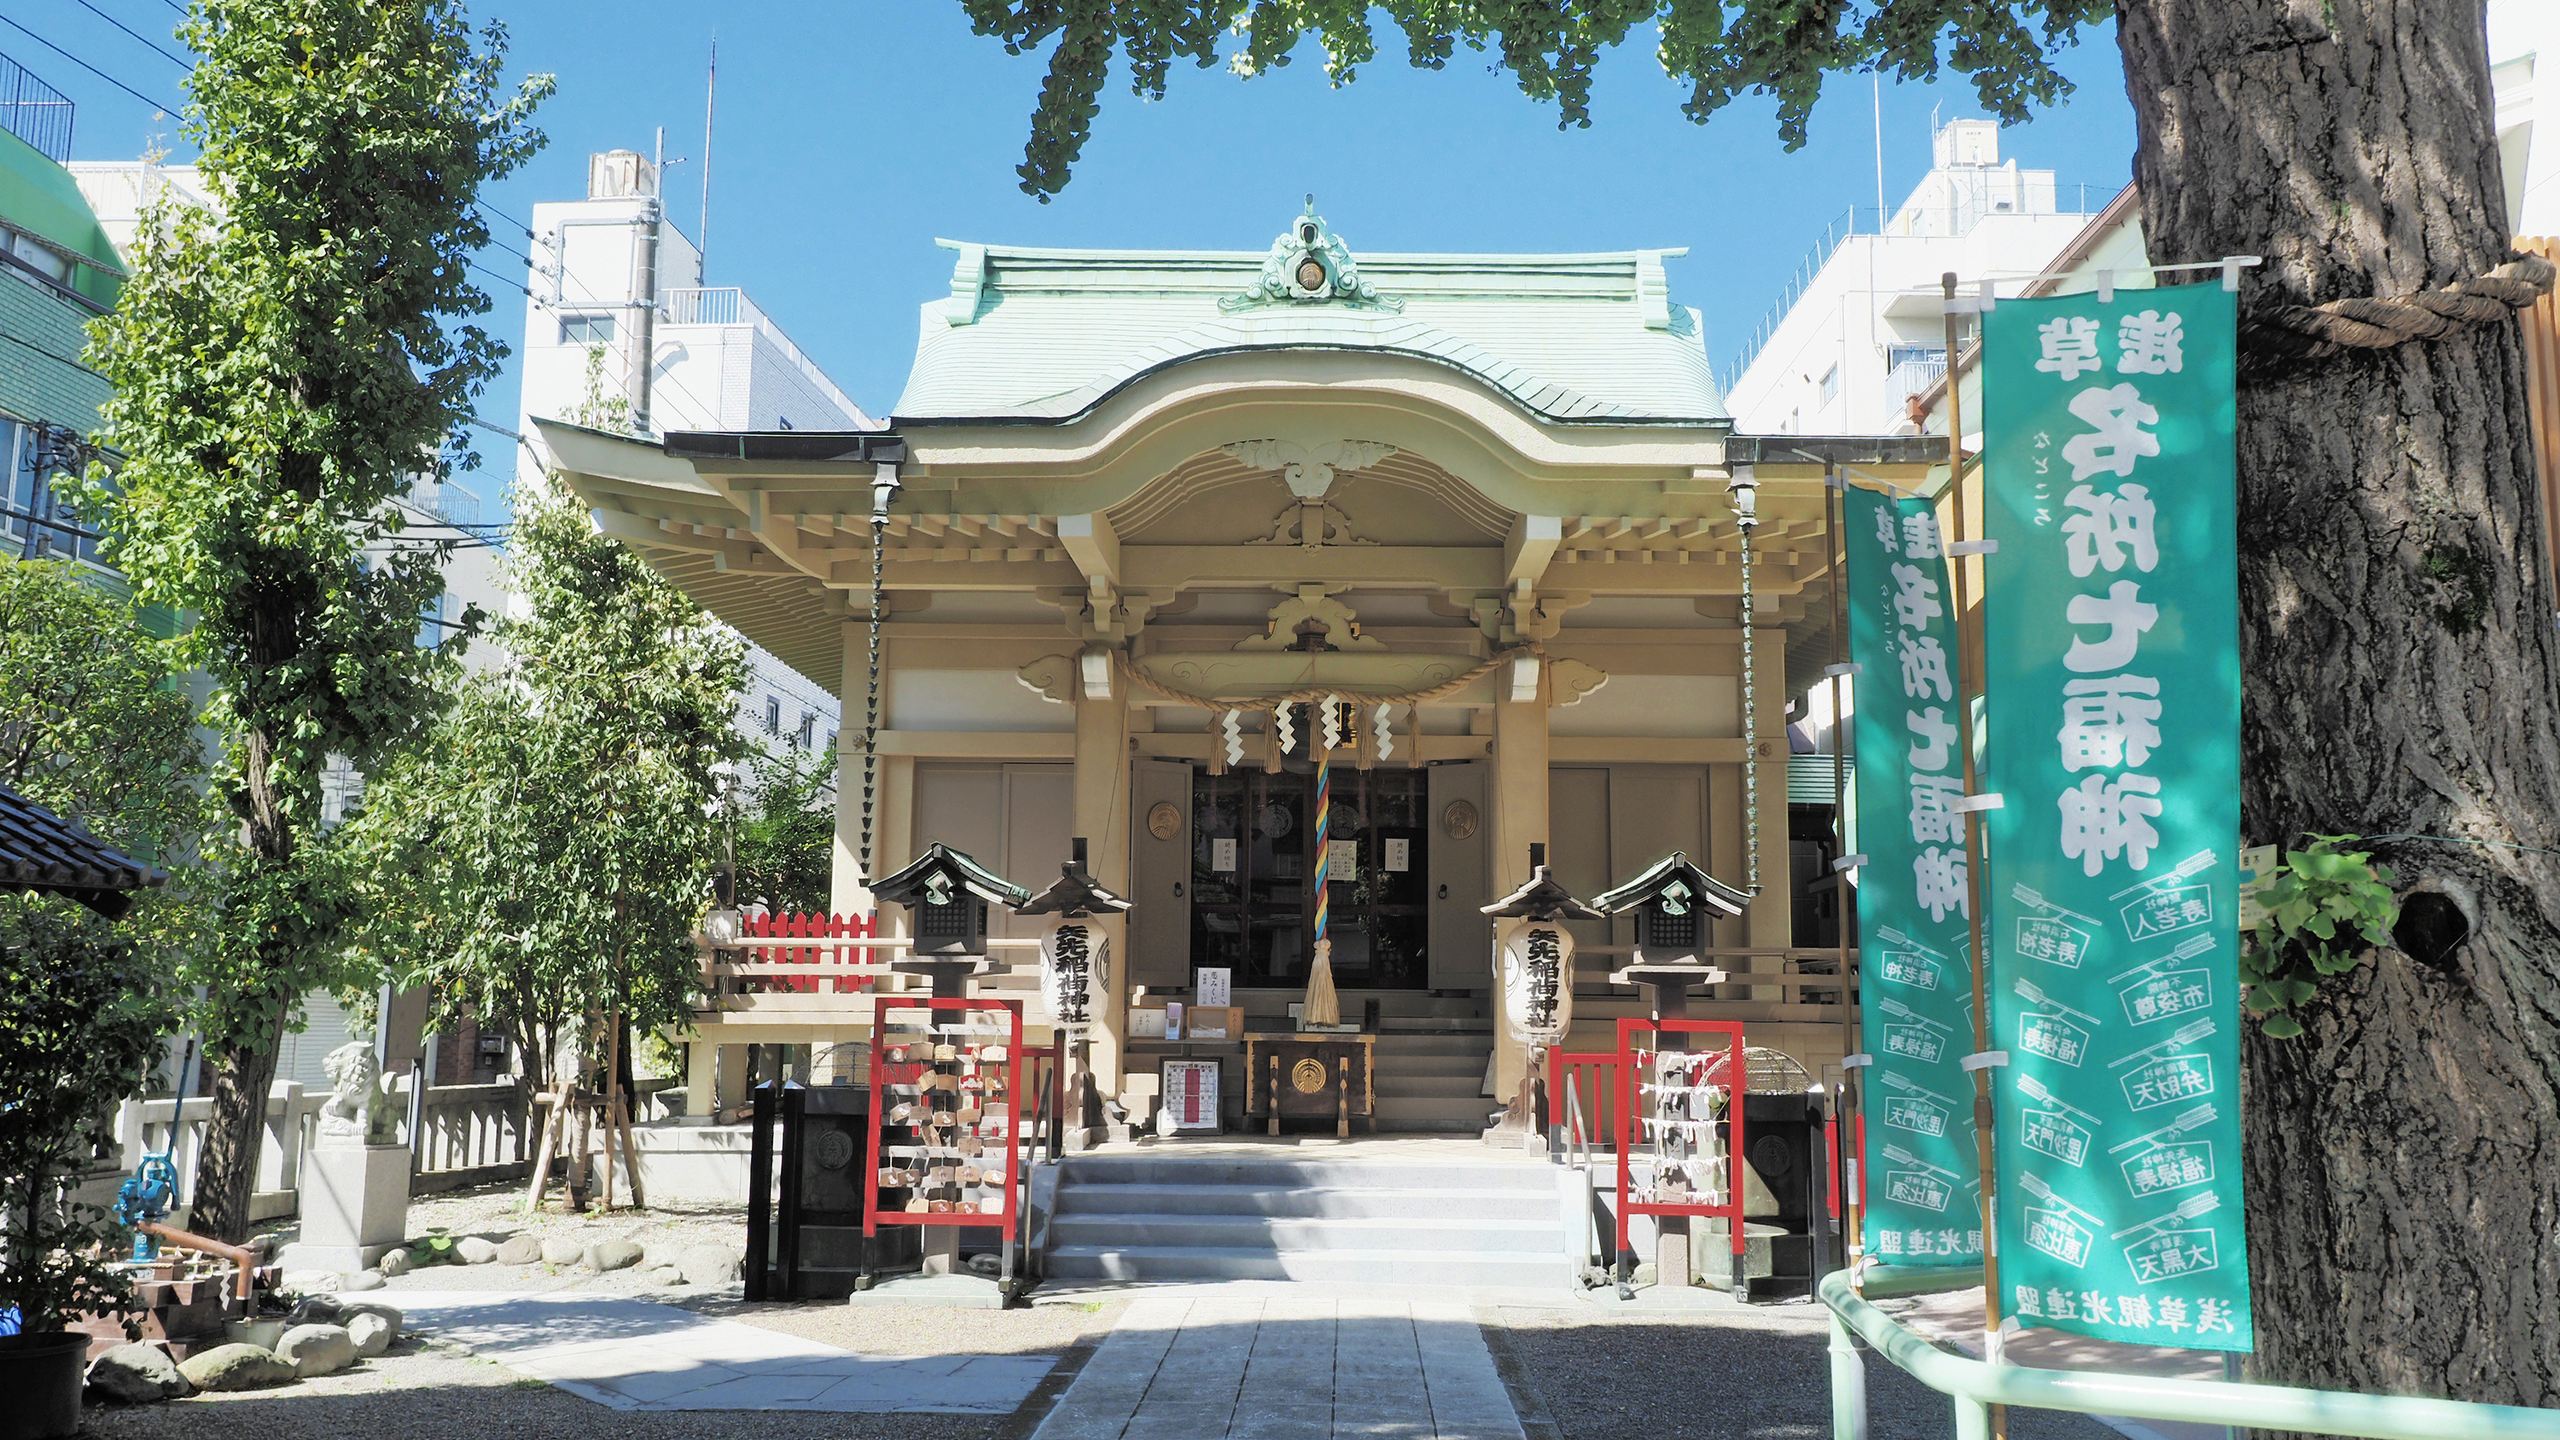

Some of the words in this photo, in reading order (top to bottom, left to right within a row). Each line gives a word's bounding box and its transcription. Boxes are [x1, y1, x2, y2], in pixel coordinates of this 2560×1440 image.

[1055, 925, 1091, 1023] 矢先稲荷神社
[1524, 928, 1560, 1029] 矢先稲荷神社
